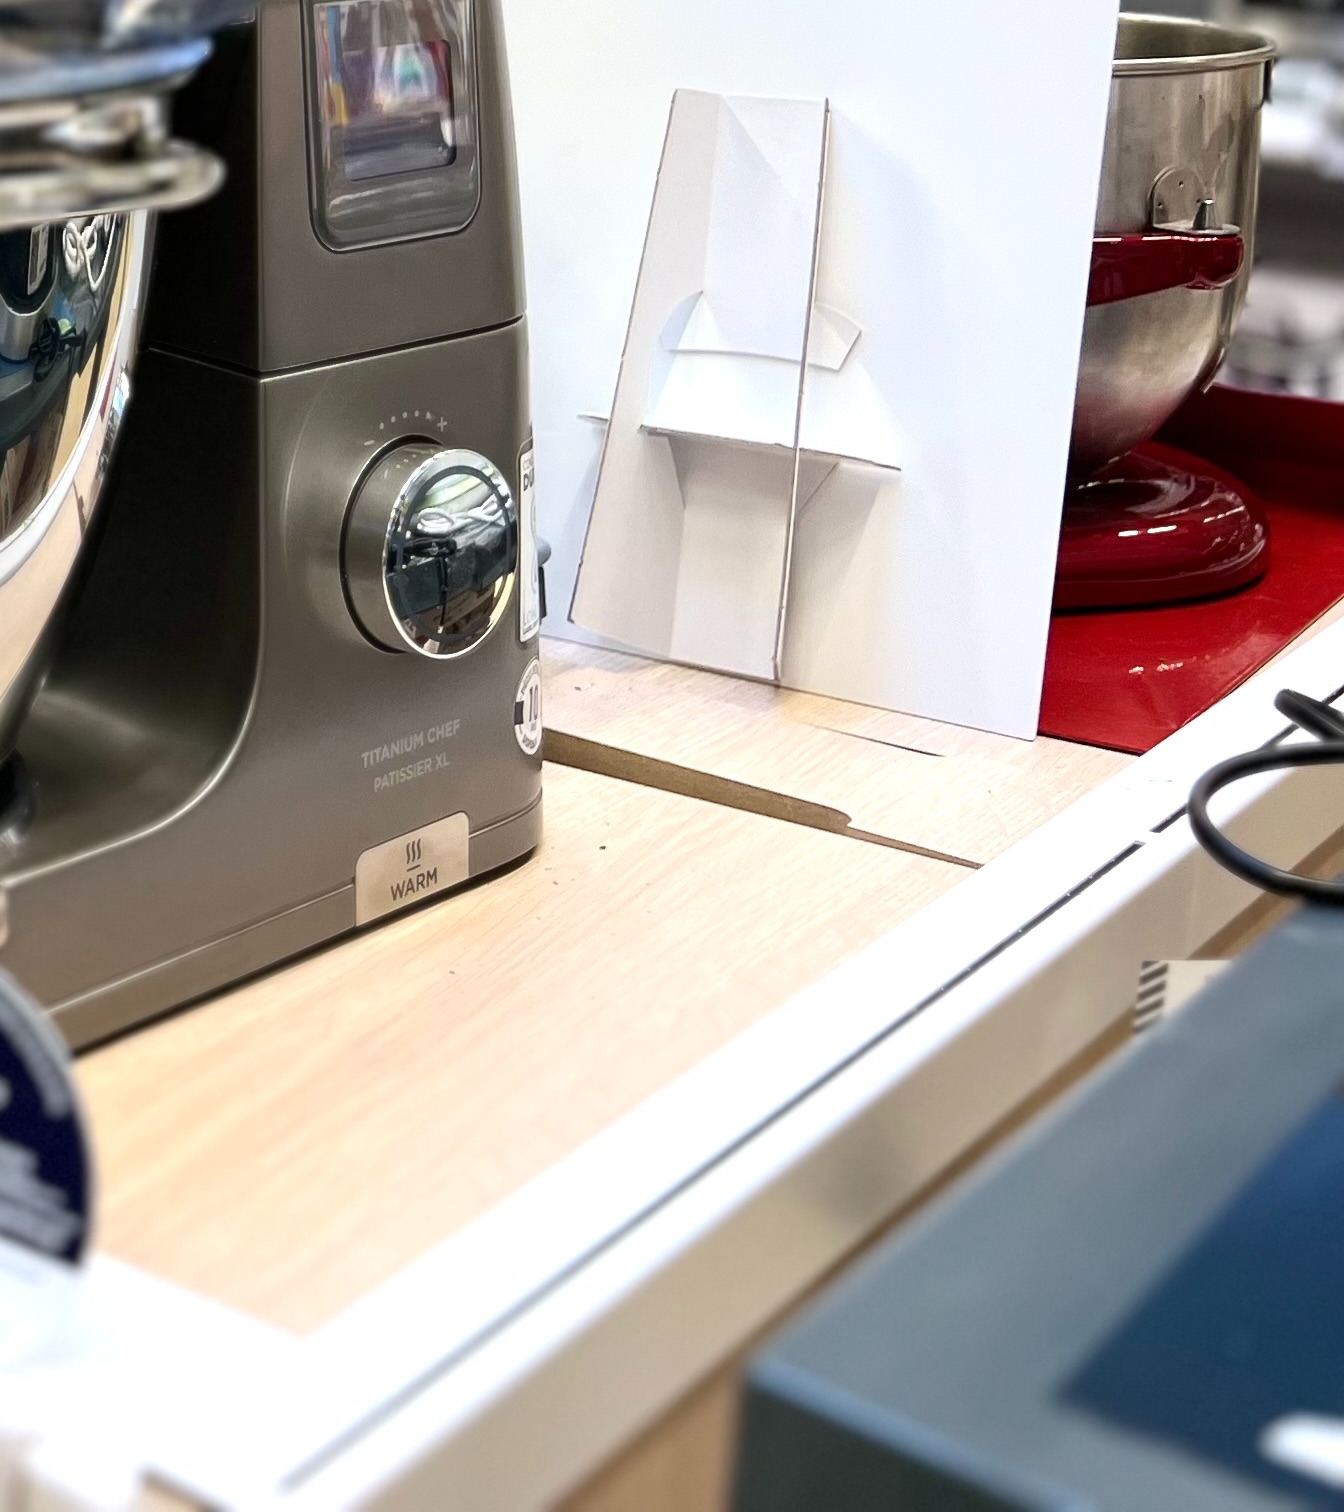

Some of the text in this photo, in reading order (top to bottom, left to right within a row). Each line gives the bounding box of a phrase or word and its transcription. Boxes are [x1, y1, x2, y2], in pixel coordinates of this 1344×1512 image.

[361, 718, 461, 769] TITANIUM CHEF
[373, 752, 450, 792] PATISSIER XL
[390, 867, 438, 901] WARM
